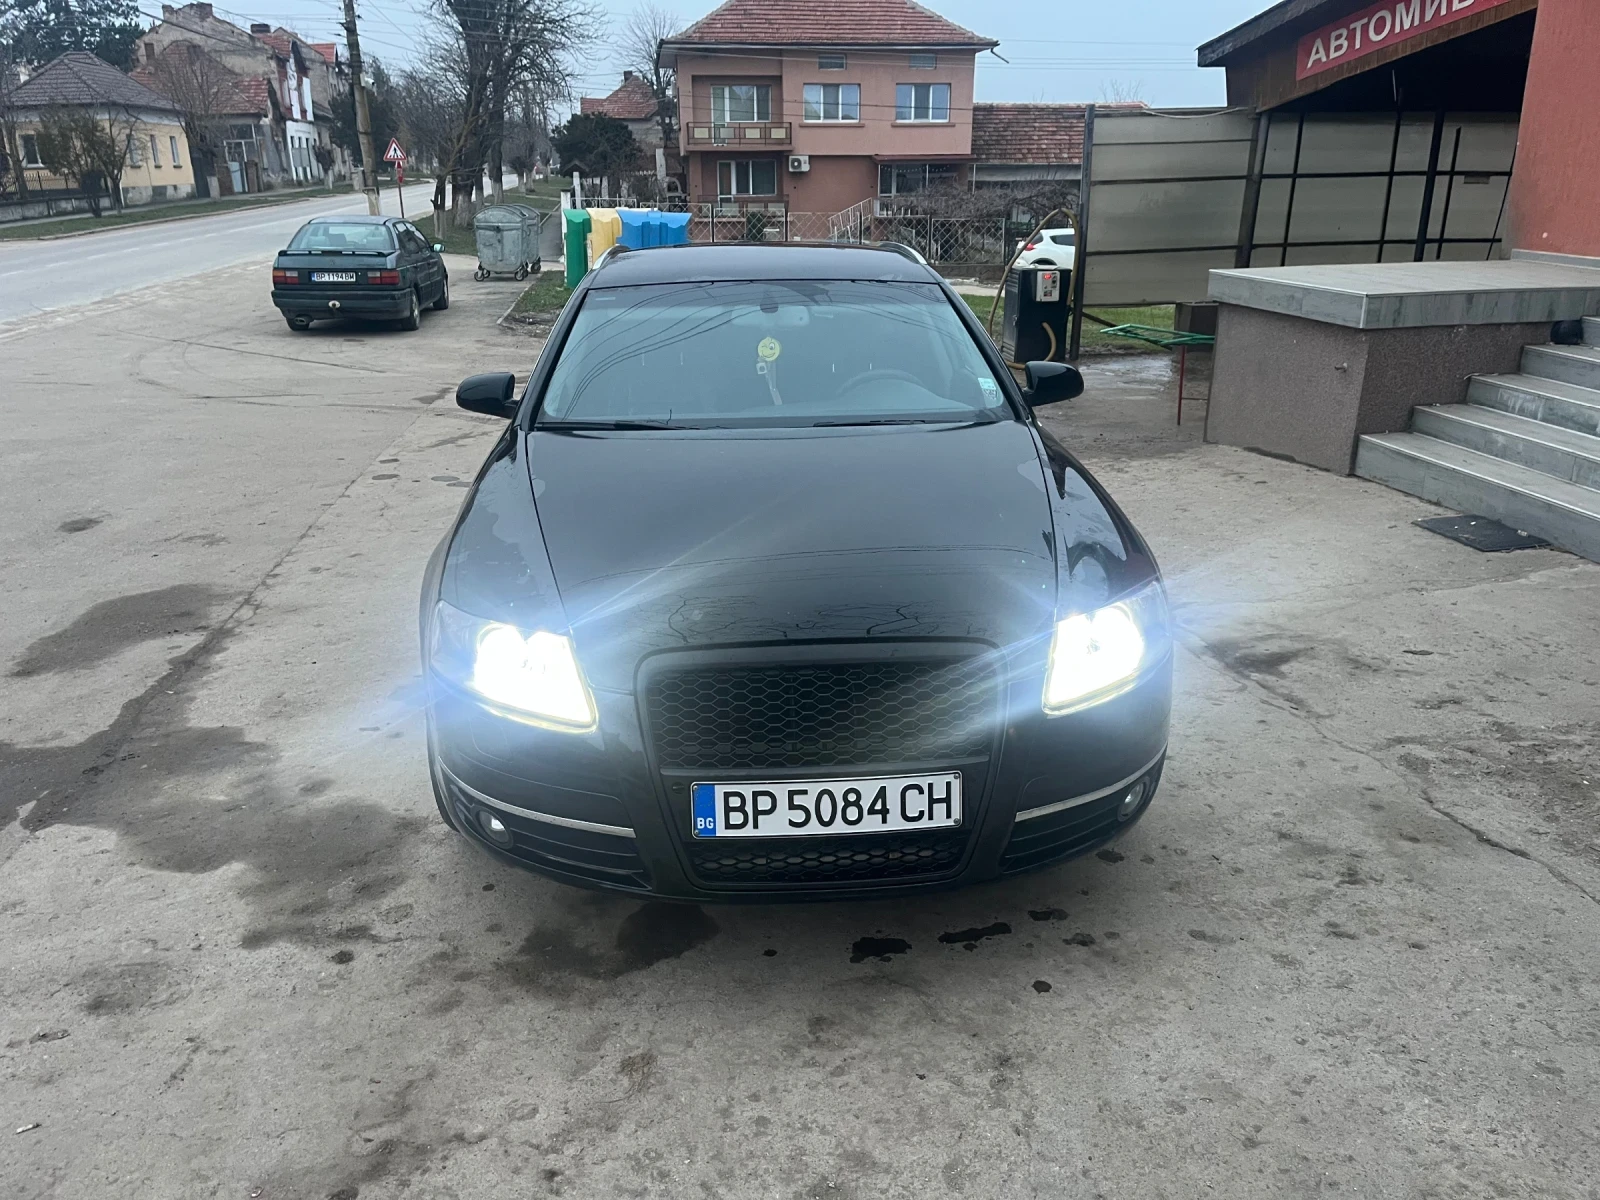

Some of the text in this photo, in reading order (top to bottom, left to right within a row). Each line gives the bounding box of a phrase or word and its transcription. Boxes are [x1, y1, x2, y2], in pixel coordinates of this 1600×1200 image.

[327, 272, 344, 280] 1194
[722, 780, 952, 830] BP 5084 CH
[696, 817, 714, 829] BG
